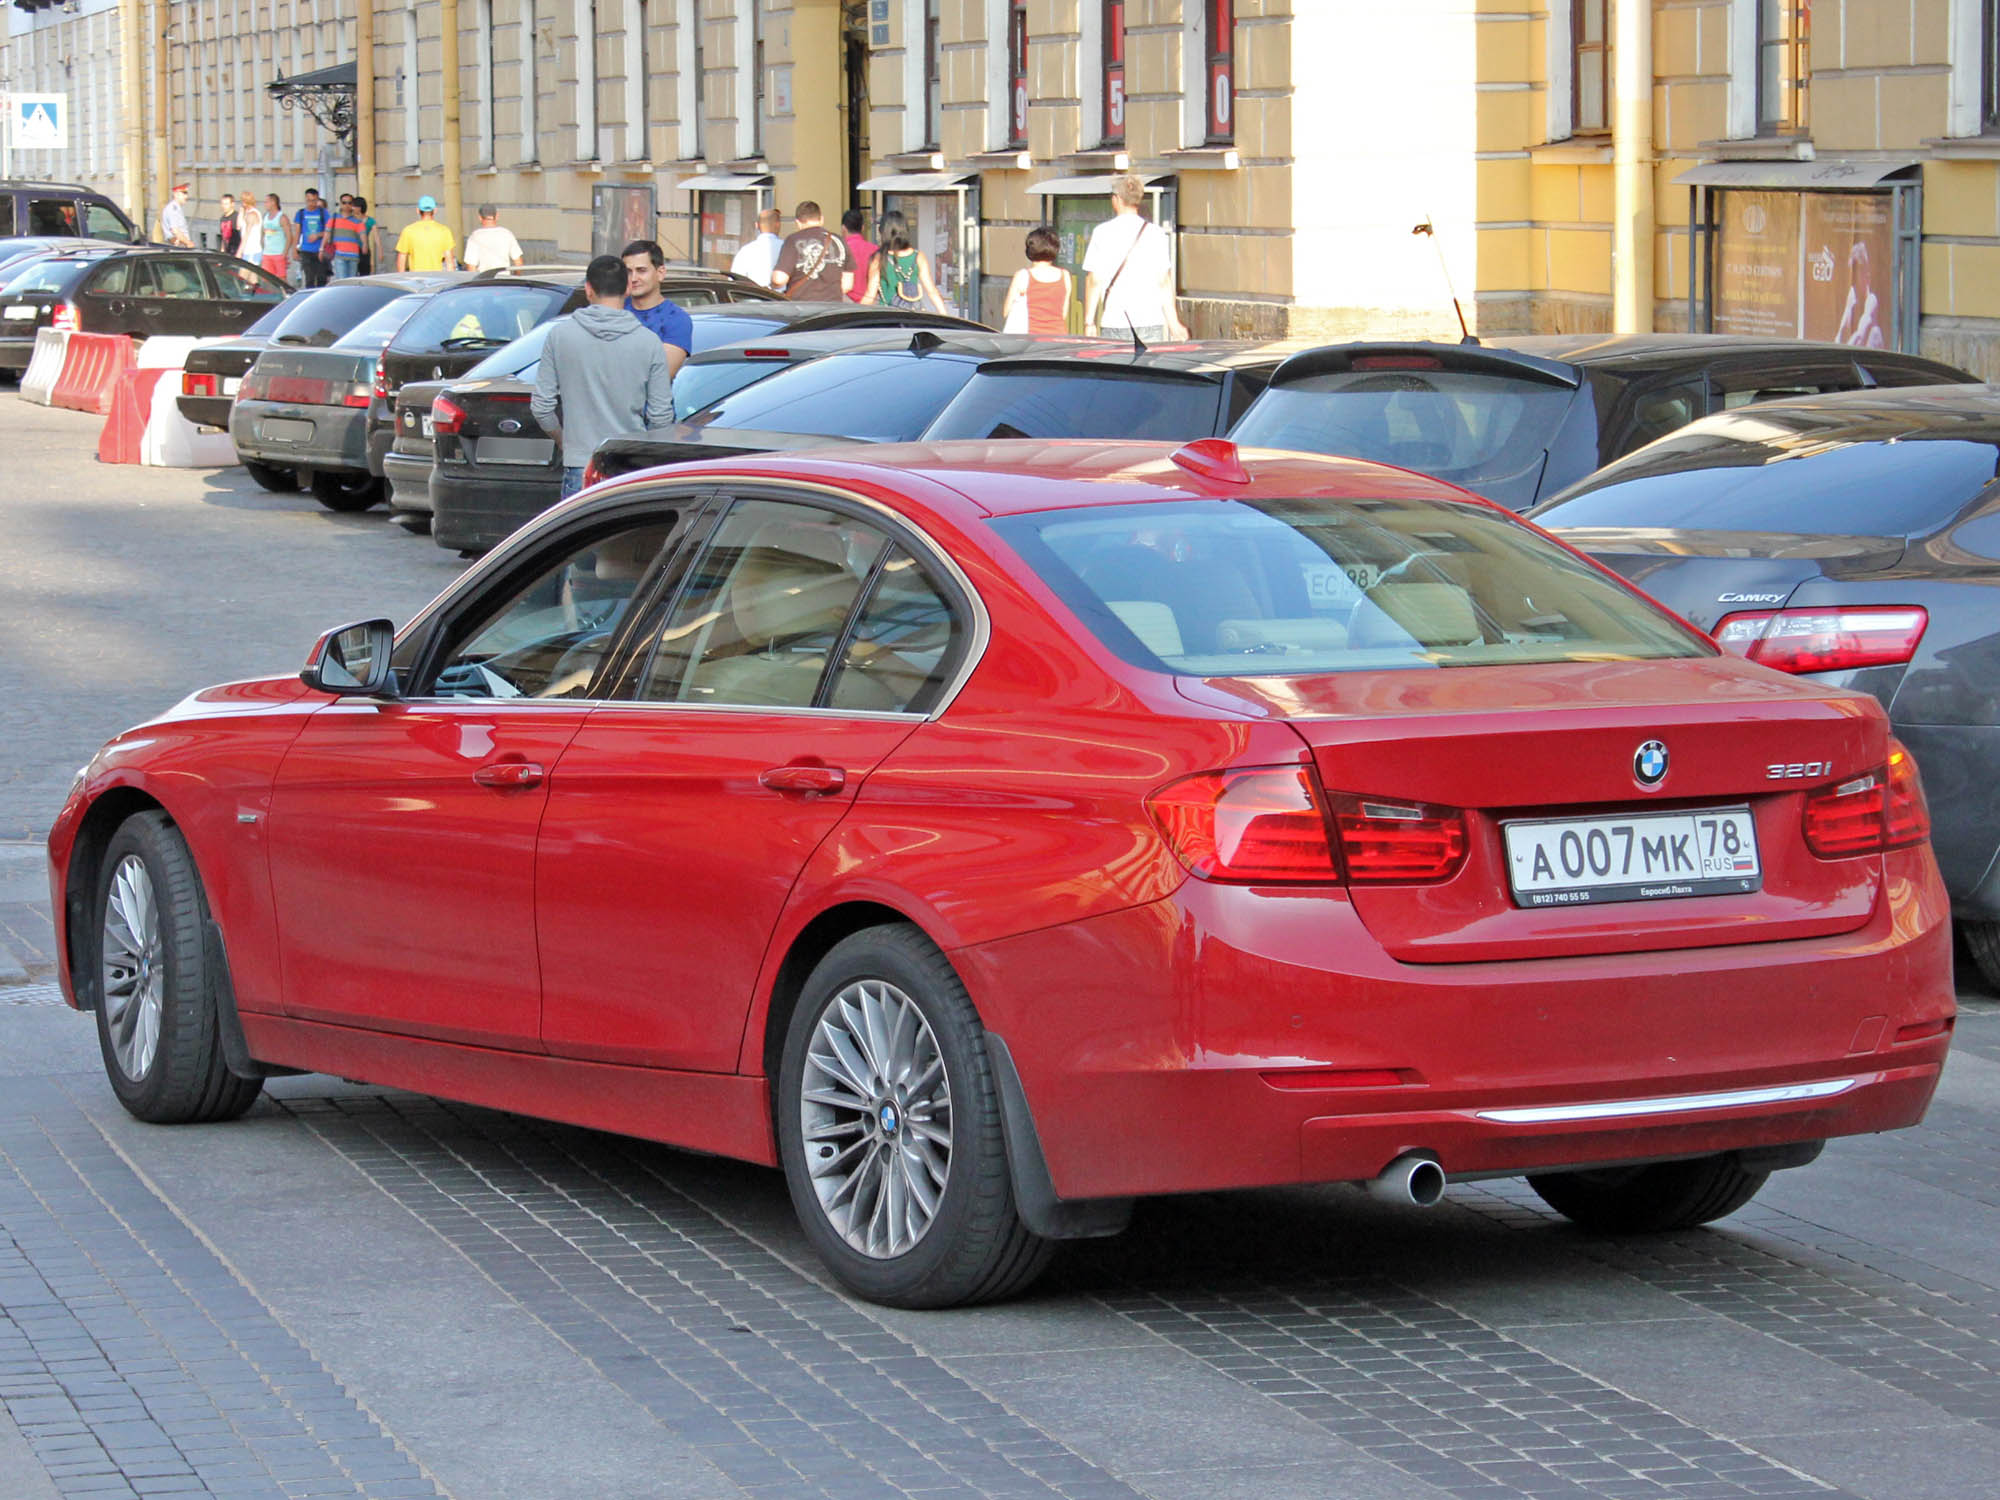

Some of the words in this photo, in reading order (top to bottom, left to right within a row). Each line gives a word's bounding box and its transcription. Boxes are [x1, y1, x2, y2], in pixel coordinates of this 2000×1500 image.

[1110, 80, 1124, 126] 5
[1215, 74, 1230, 124] 0
[1717, 592, 1787, 604] CAMRY
[1765, 761, 1833, 780] 320i
[1700, 819, 1741, 857] 78
[1703, 857, 1733, 872] RUS
[1532, 893, 1554, 904] (812)
[1554, 892, 1569, 902] 740
[1569, 892, 1579, 901] 55
[1580, 891, 1590, 901] 55
